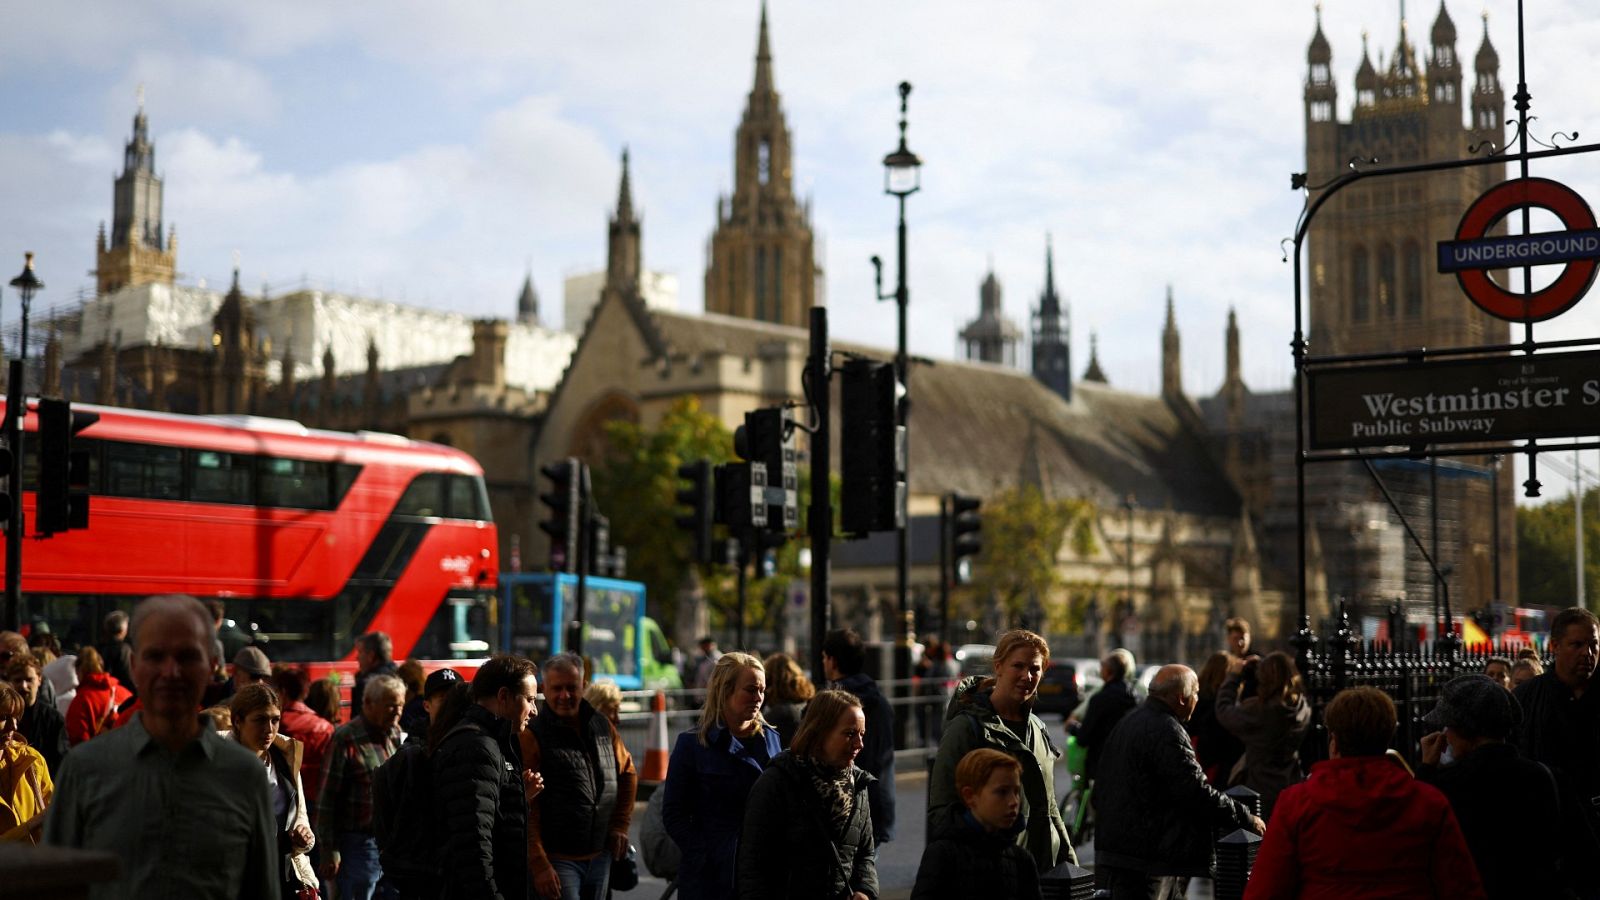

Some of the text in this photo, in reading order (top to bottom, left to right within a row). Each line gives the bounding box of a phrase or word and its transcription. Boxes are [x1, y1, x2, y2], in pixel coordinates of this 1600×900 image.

[1455, 236, 1598, 262] UNDERGROUND
[1362, 387, 1570, 418] Westminster
[1352, 415, 1496, 437] Public Subway
